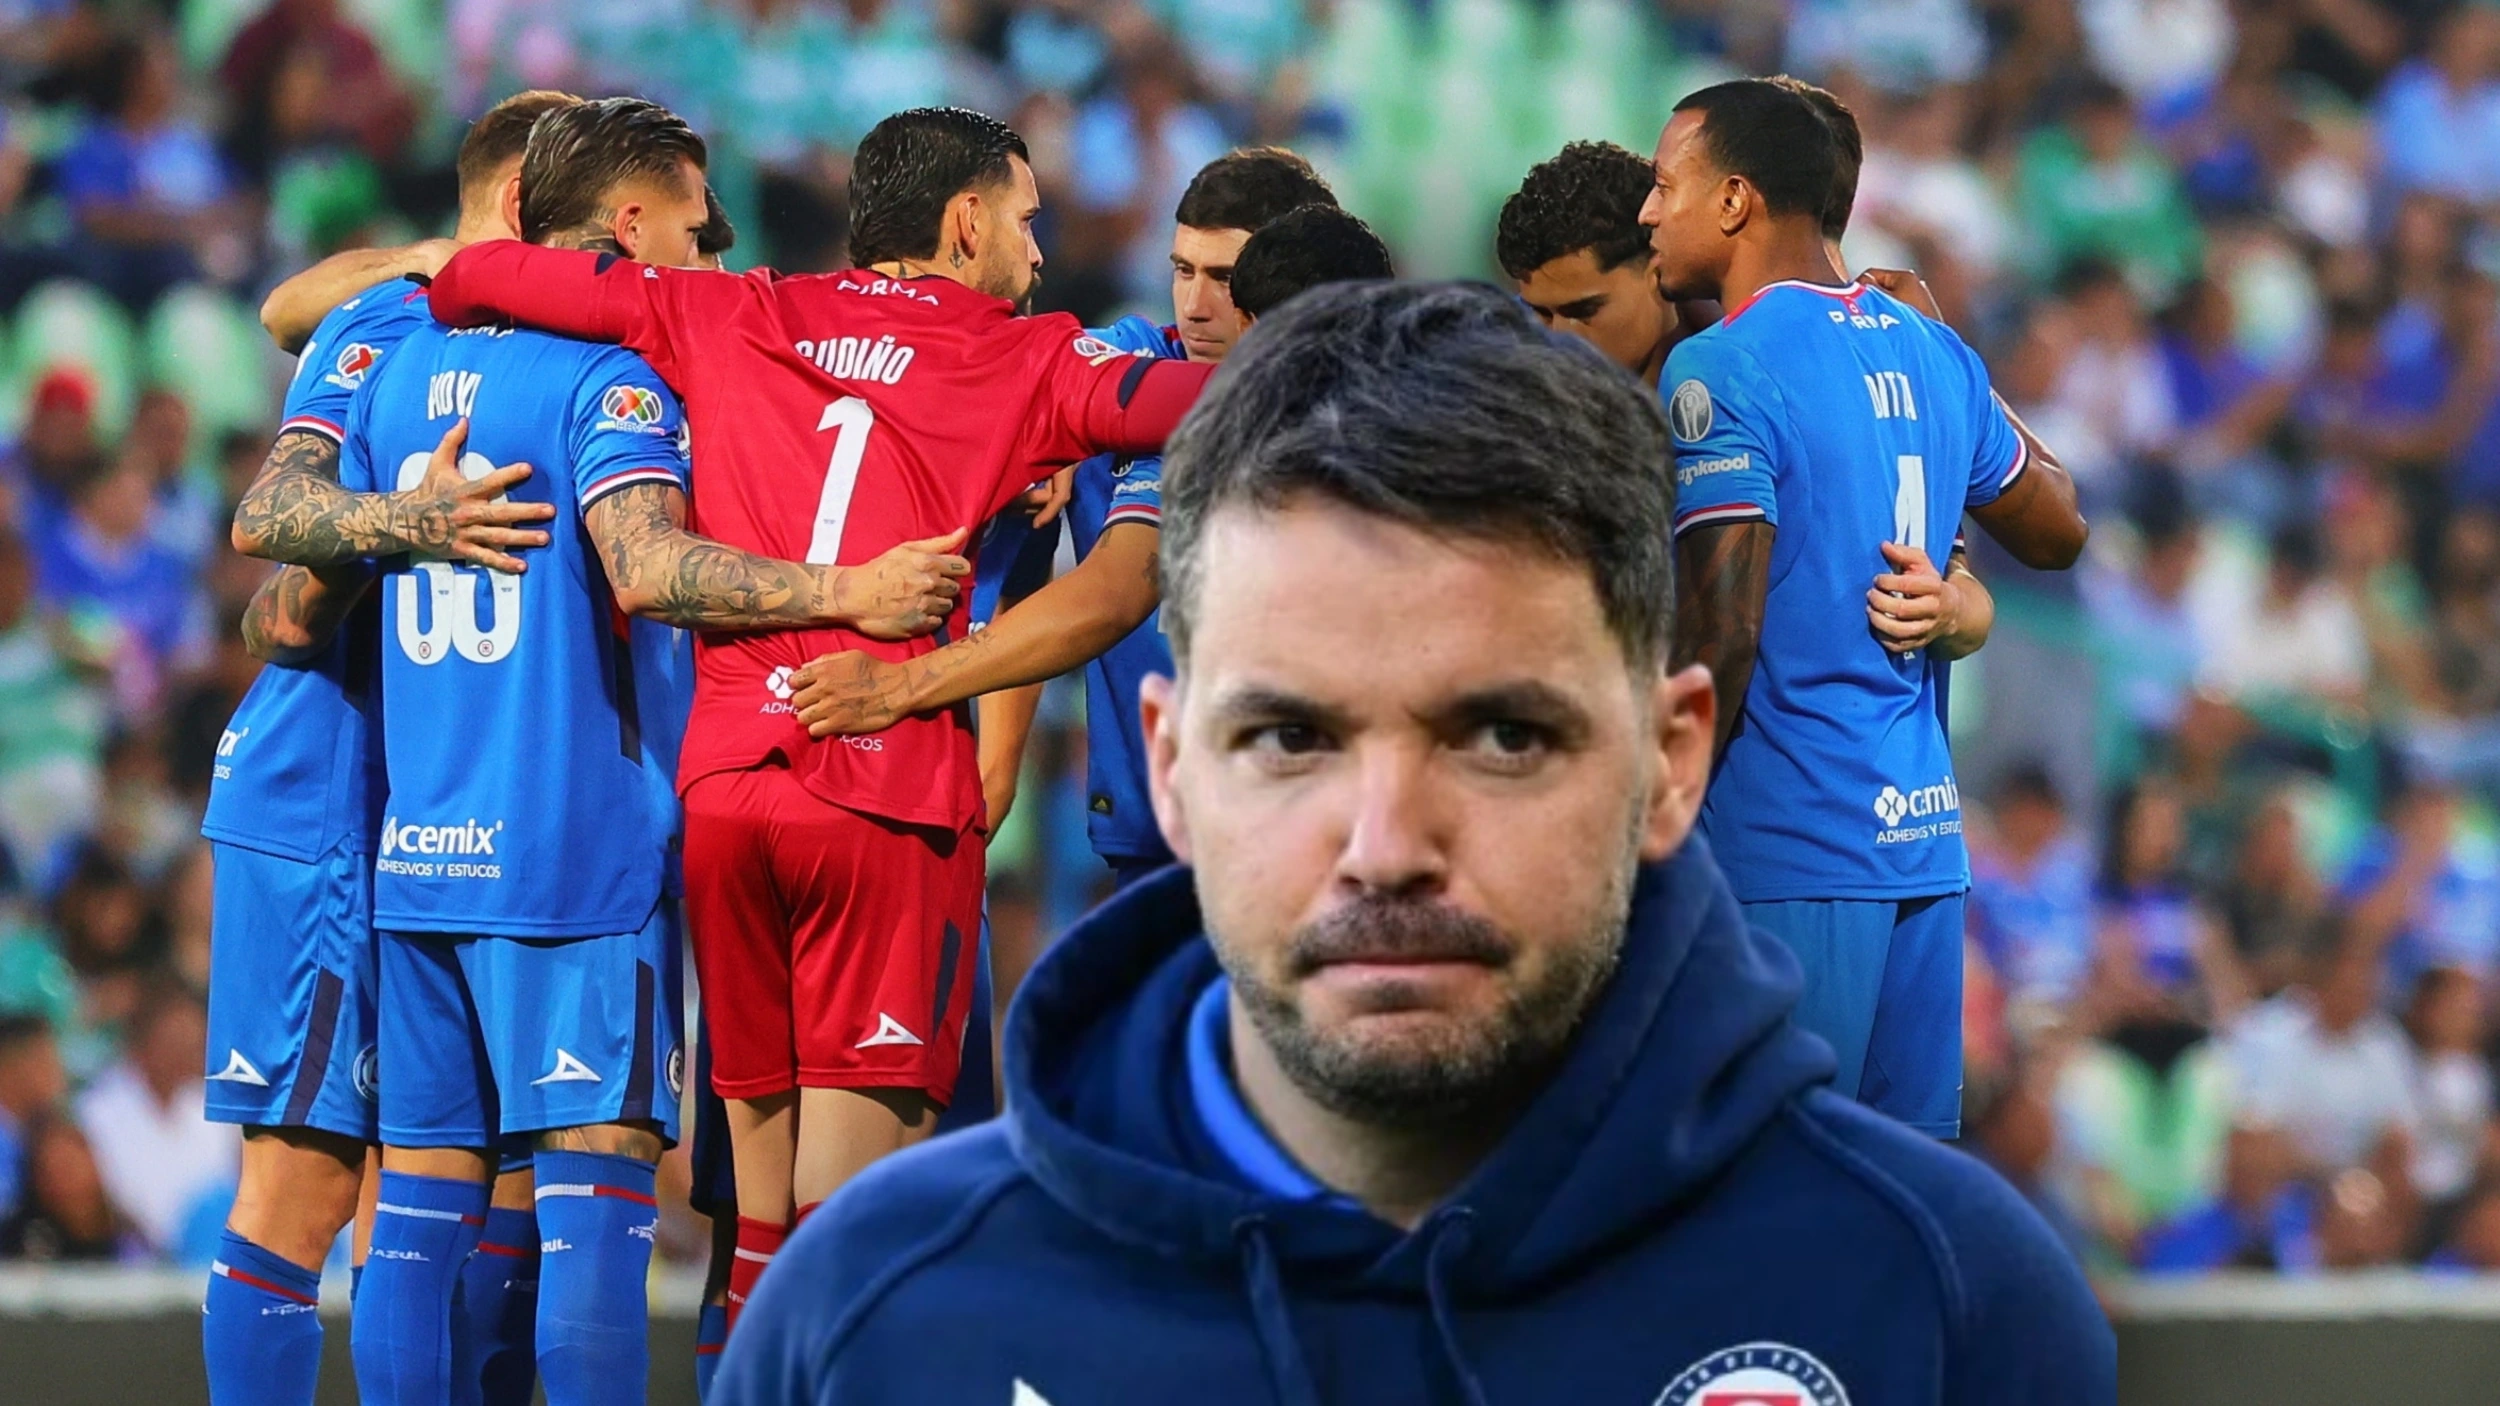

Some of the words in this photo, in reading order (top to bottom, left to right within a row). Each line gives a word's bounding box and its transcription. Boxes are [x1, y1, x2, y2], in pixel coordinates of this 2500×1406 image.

[837, 279, 939, 306] PIRMA
[1828, 311, 1900, 329] PRMA
[806, 396, 874, 565] 1
[398, 818, 495, 855] cemix
[1928, 823, 1938, 837] Y
[436, 863, 445, 876] Y
[447, 863, 501, 878] ESTUCOS
